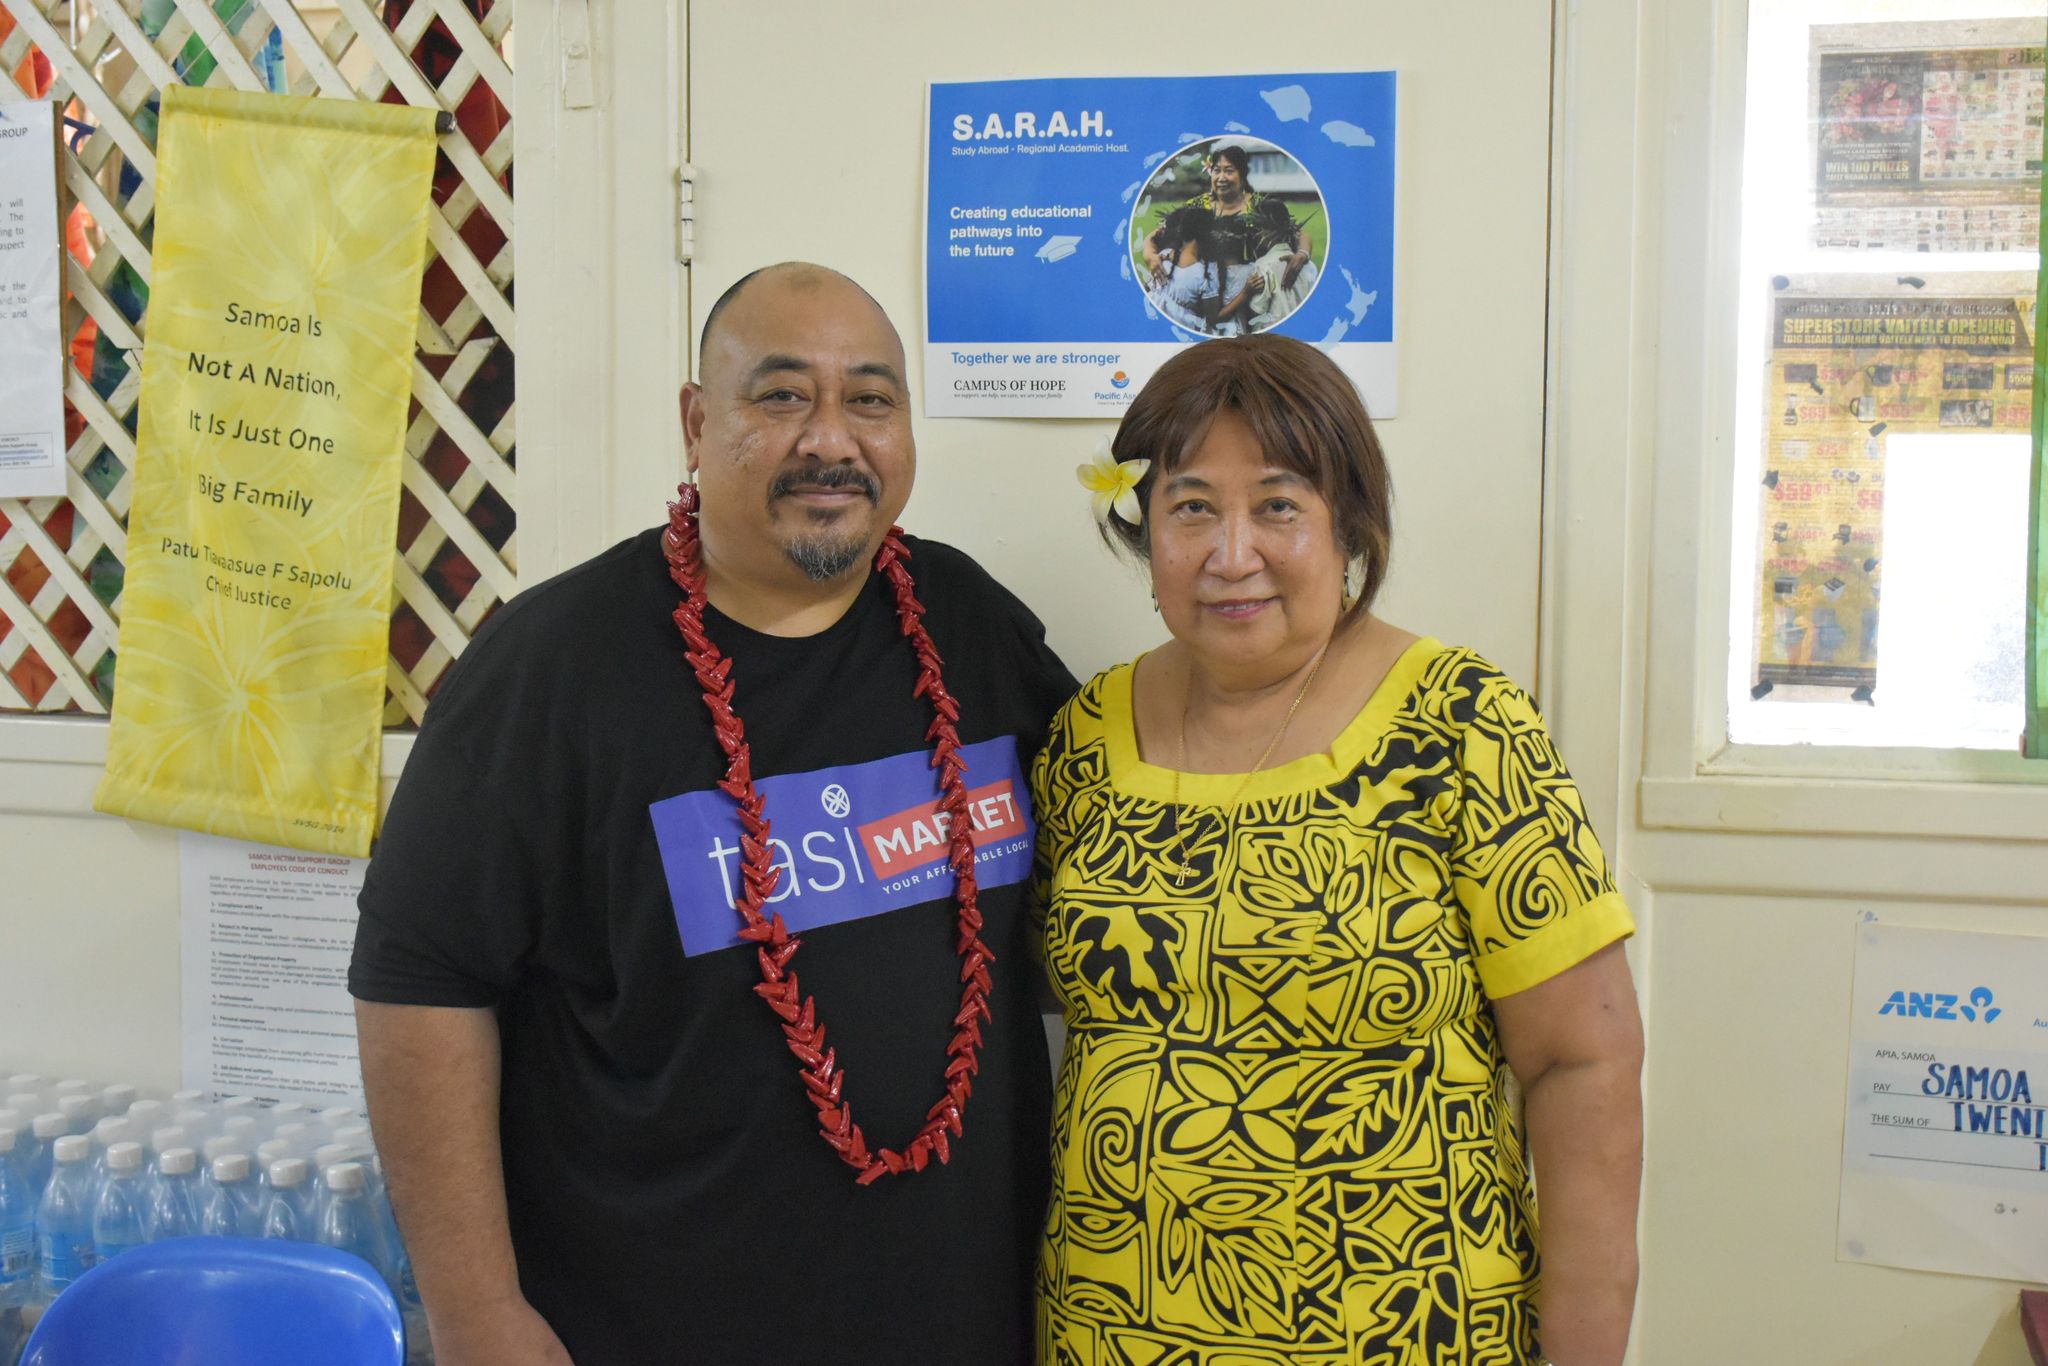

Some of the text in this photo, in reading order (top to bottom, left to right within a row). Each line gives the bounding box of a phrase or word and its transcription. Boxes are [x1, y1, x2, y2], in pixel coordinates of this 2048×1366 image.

[0, 127, 28, 138] ROUP
[952, 110, 1113, 141] S.A.R.A.H.
[952, 146, 975, 156] Study
[978, 145, 1009, 155] Abroad
[1017, 144, 1056, 155] Regional
[1059, 143, 1103, 153] Academic
[1105, 143, 1130, 153] Host.
[950, 204, 1092, 220] Creating educational
[950, 225, 1043, 240] pathways into
[949, 244, 1014, 257] the future
[225, 302, 322, 337] Samoa Is
[1783, 318, 2016, 334] SUPERSTORE VAITELE OPENING
[952, 352, 1121, 366] Together we are stronger
[188, 352, 341, 401] Not A Nation,
[954, 380, 1066, 391] CAMPUS OF HOPE
[1094, 392, 1121, 400] Pacific
[189, 410, 335, 454] It Is Just One
[198, 474, 313, 517] Big Family
[161, 537, 199, 559] Patu
[272, 562, 285, 579] F
[288, 565, 352, 590] Sapolu
[206, 575, 292, 610] Chief Justice
[248, 853, 272, 862] SAMOA
[272, 854, 296, 863] VICTIM
[297, 856, 326, 864] SUPPORT
[251, 863, 287, 872] EMPLOYEES
[288, 865, 306, 873] CODE
[317, 867, 349, 876] CONDUCT
[883, 875, 920, 894] YOUR
[1878, 991, 1958, 1020] ANZ
[1875, 1049, 1936, 1062] APIA, SAMOA
[1873, 1083, 1891, 1091] PAY
[1921, 1062, 2032, 1104] SAMOA
[1872, 1113, 1931, 1127] THE SUM OF
